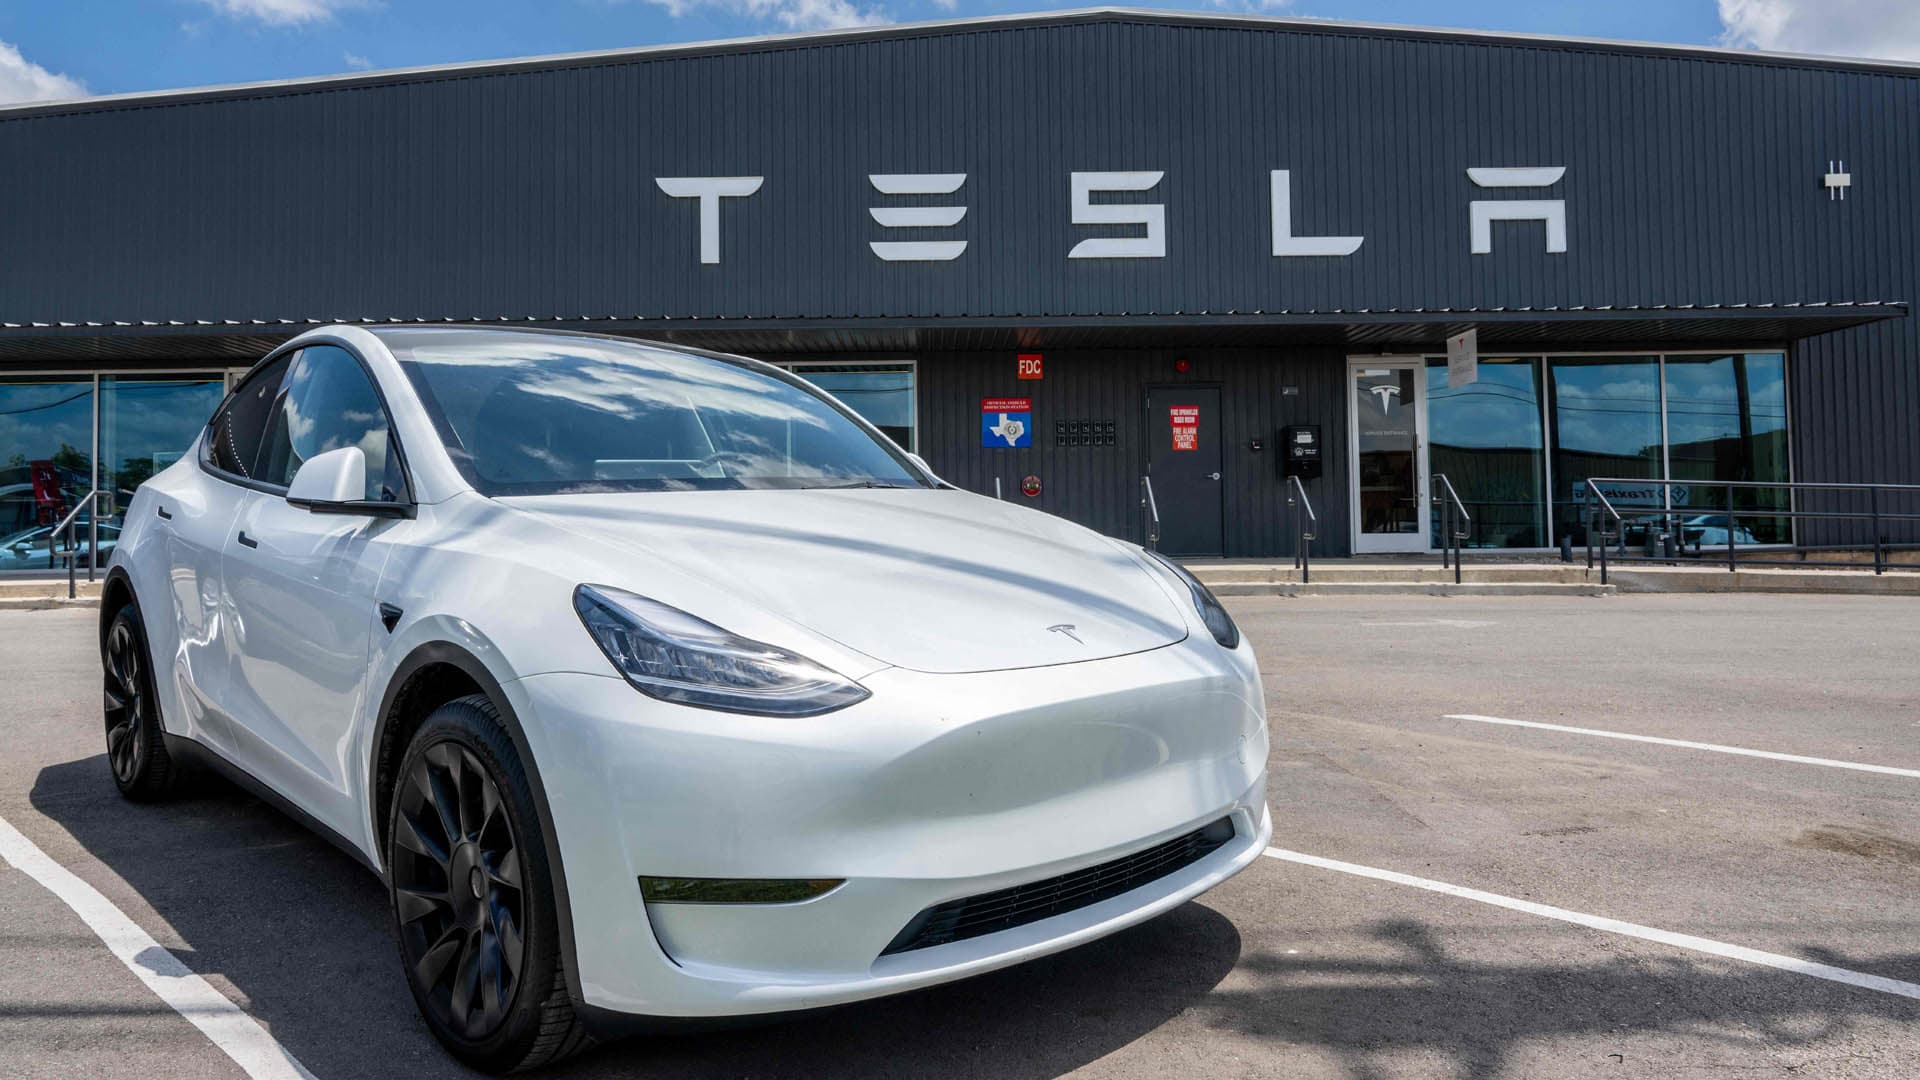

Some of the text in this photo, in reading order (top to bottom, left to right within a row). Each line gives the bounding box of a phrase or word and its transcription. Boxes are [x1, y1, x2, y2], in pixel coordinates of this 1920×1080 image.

[656, 167, 1566, 264] TESLA
[1019, 359, 1041, 374] FDC
[1175, 434, 1195, 442] CONTROL
